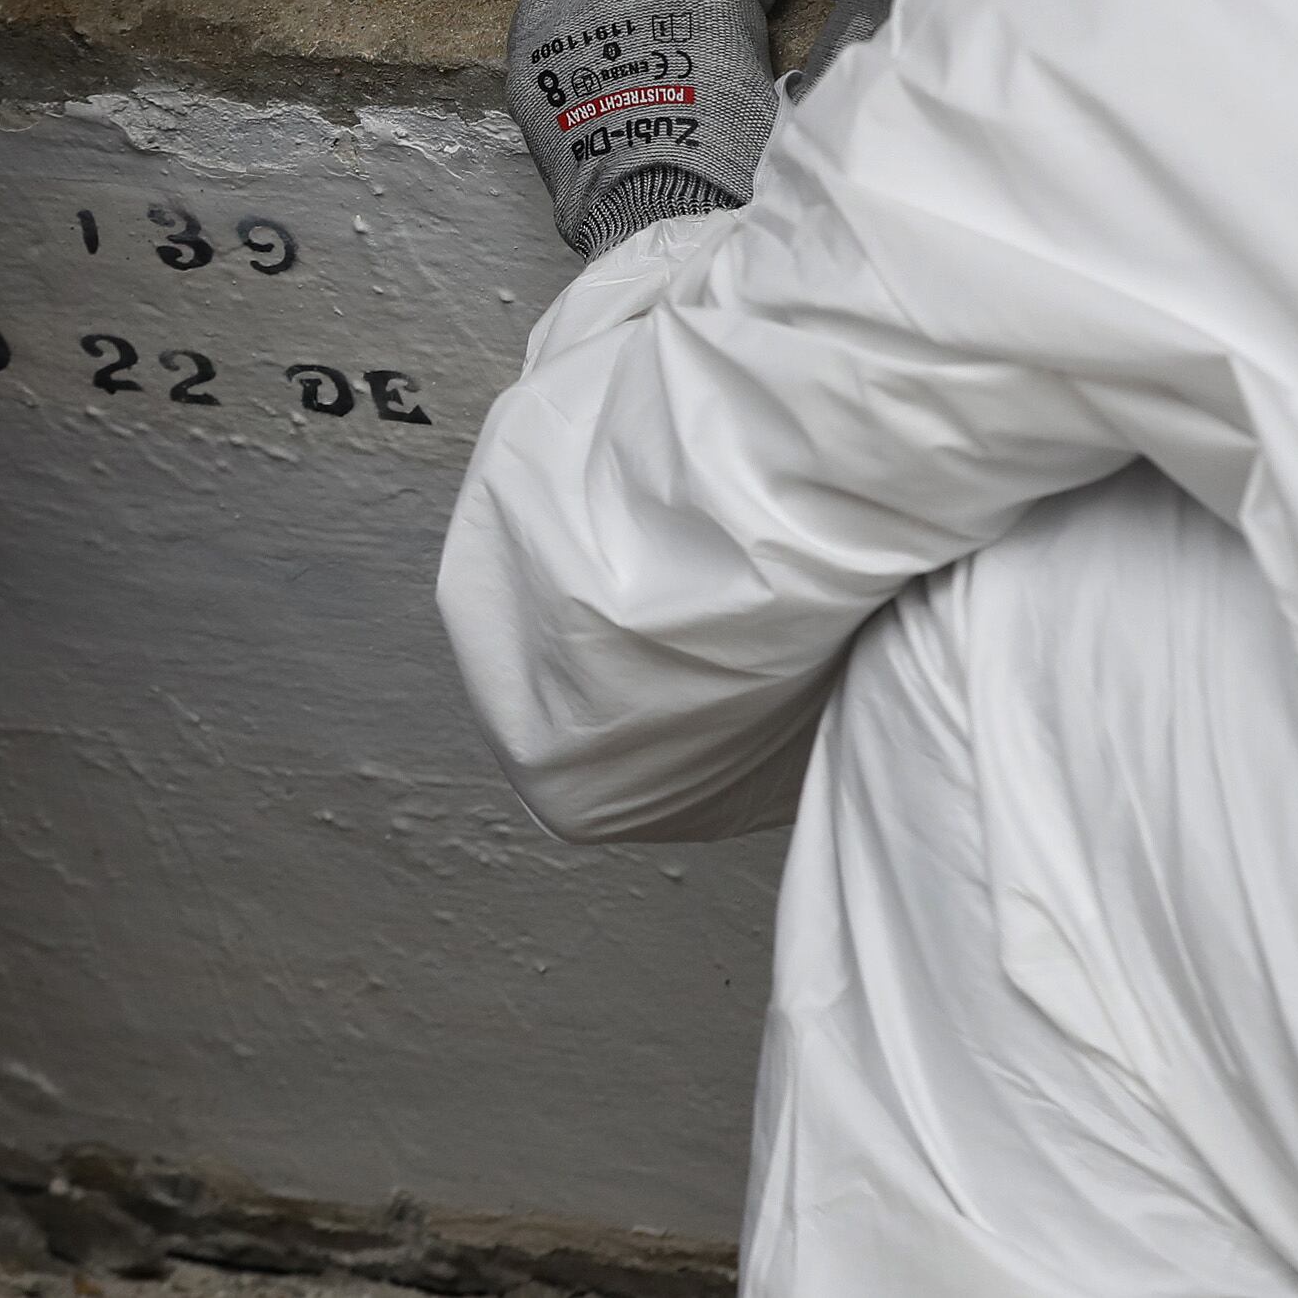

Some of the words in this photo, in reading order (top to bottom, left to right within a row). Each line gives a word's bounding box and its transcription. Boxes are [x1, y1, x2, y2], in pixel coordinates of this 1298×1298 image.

[538, 69, 566, 107] 8
[599, 87, 684, 113] POLISTRECHT
[565, 104, 597, 127] GRAY
[82, 333, 221, 406] 22
[285, 363, 433, 425] DE
